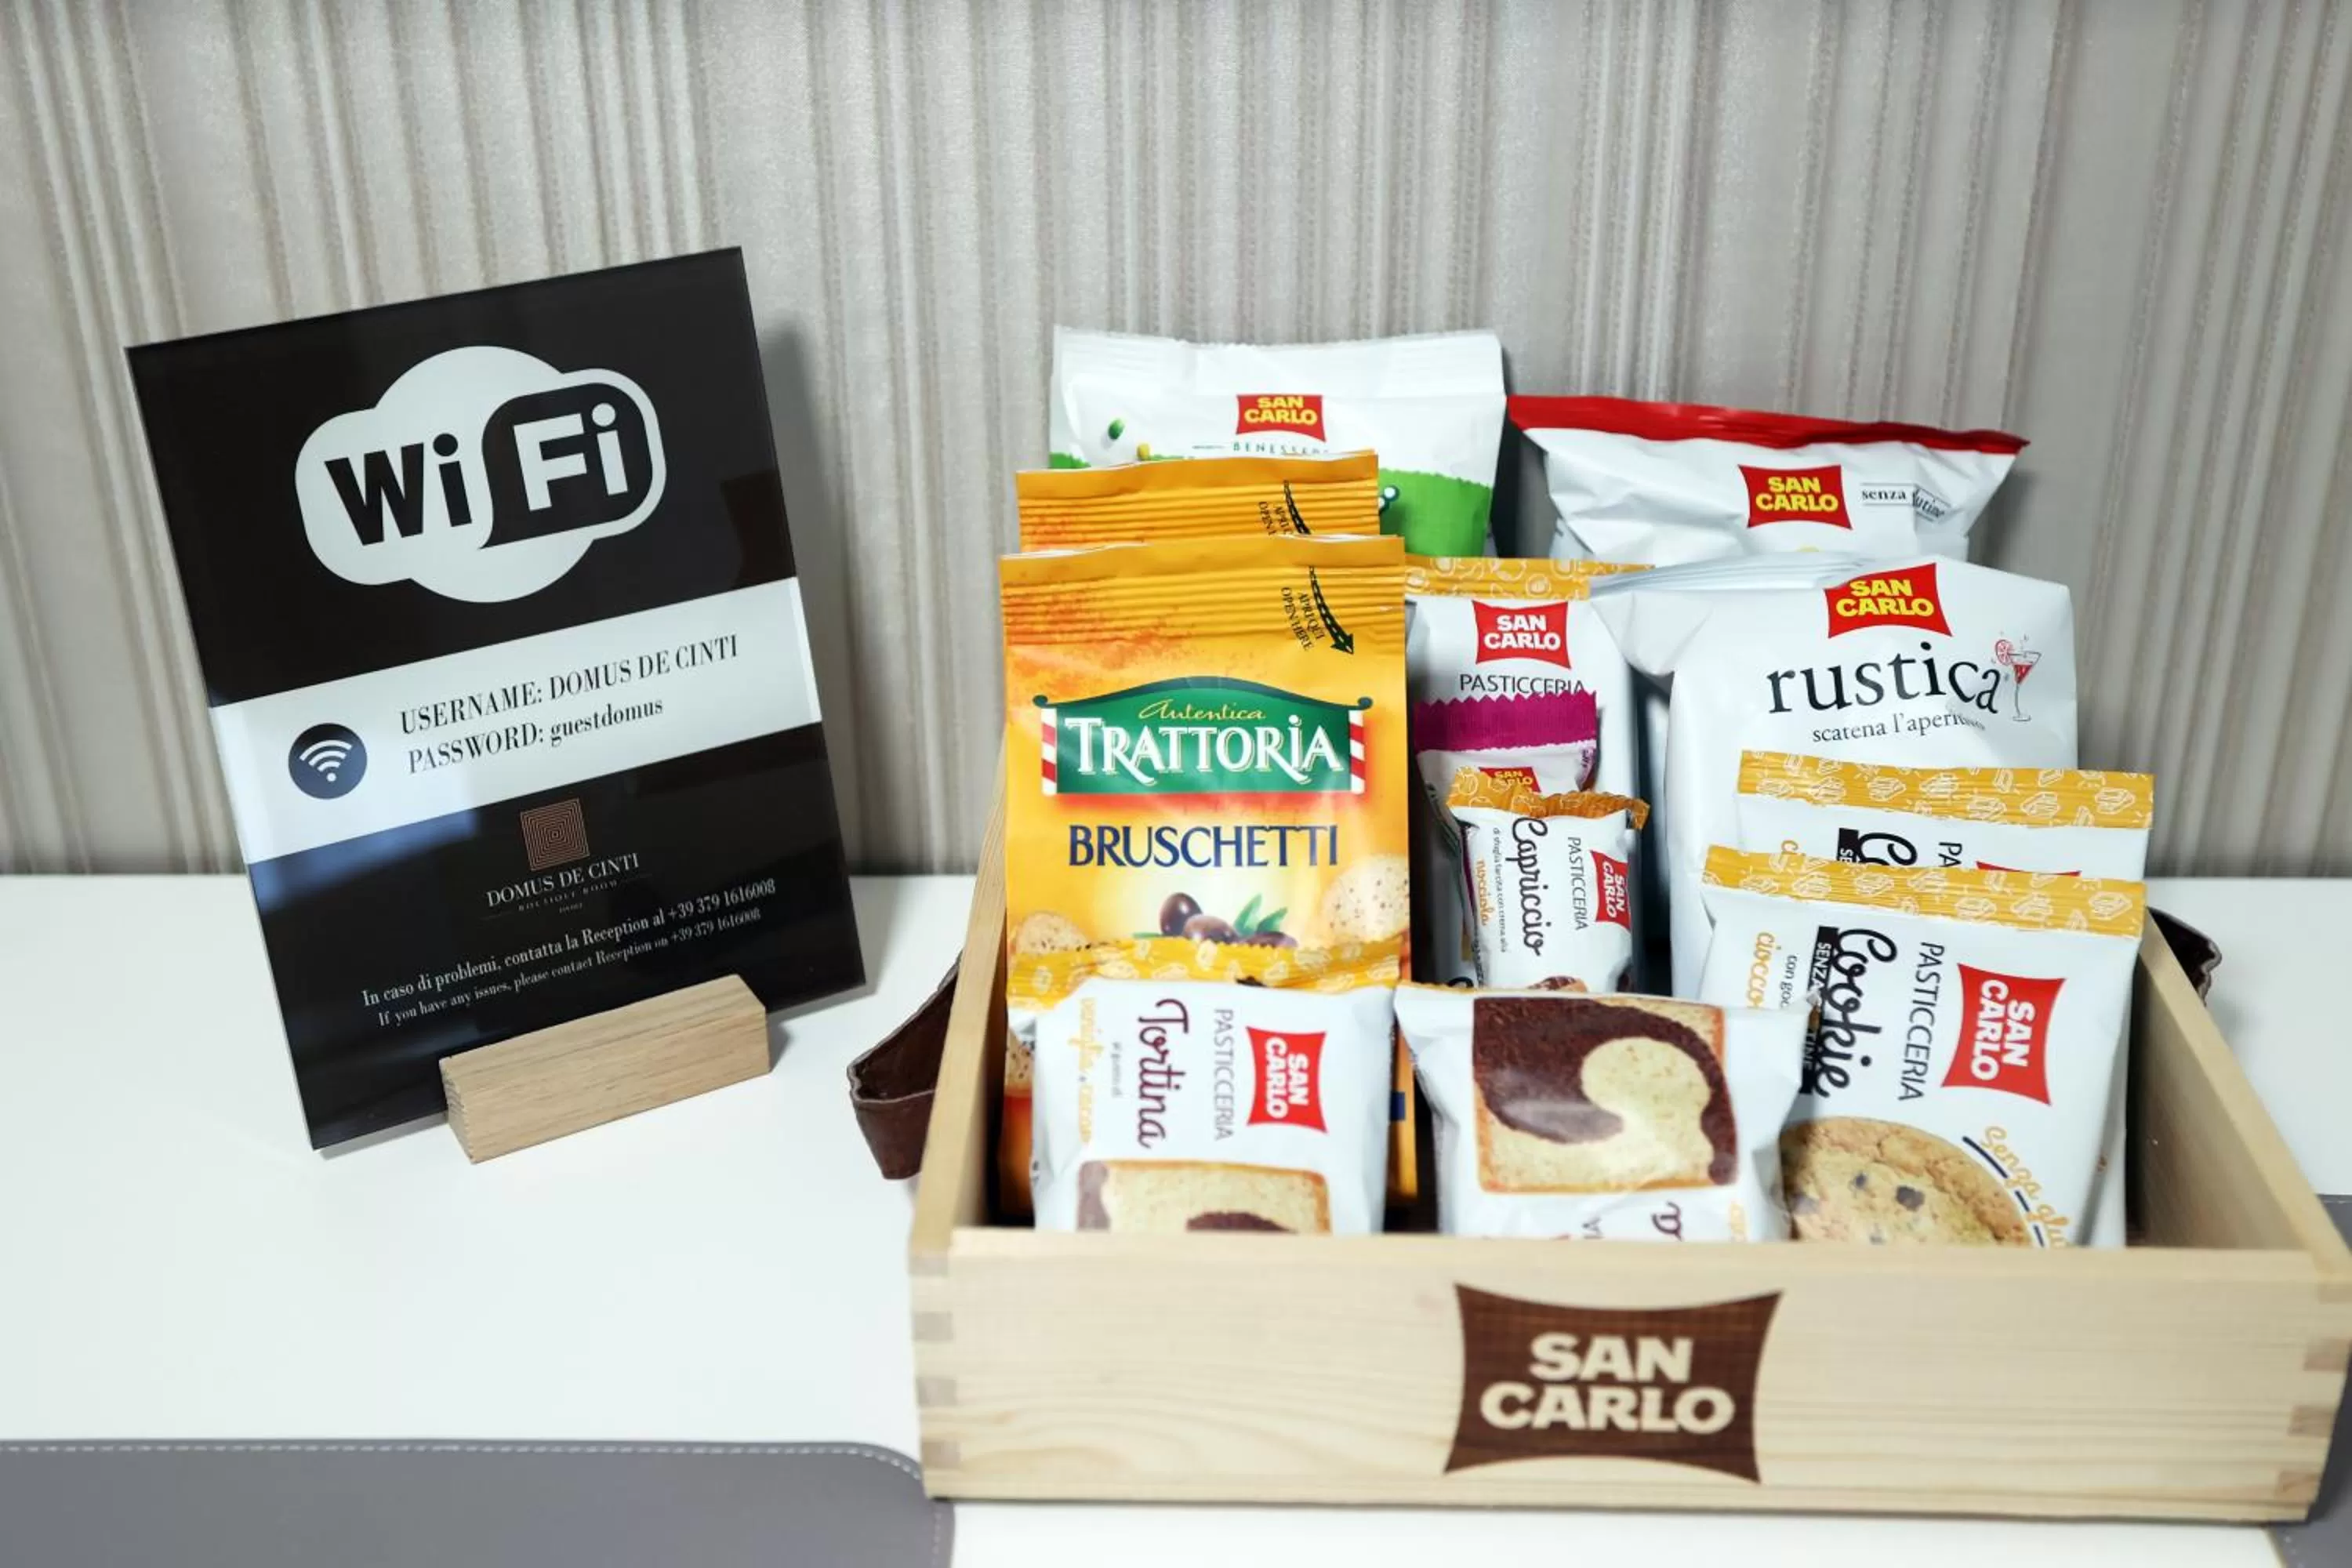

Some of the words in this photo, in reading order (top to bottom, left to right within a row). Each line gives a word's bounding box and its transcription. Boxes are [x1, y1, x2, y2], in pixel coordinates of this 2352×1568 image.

[1243, 408, 1318, 426] CARLO
[1257, 396, 1305, 409] SAN
[1755, 493, 1838, 513] CARLO
[1767, 476, 1820, 493] SAN
[1862, 489, 1906, 500] senza
[1835, 597, 1935, 618] CARLO
[1849, 579, 1913, 598] SAN
[1281, 586, 1296, 620] OPEN
[1290, 615, 1315, 651] HERE
[1298, 592, 1315, 619] APRI
[1307, 619, 1325, 640] QUI
[1484, 632, 1561, 651] CARLO
[1497, 615, 1547, 632] SAN
[400, 681, 543, 735] USERNAME:
[549, 659, 633, 702] DOMUS
[637, 650, 671, 681] DE
[676, 633, 739, 670] CINTI
[1460, 673, 1585, 695] PASTICCERIA
[1766, 641, 2002, 714] rustica
[408, 720, 544, 775] PASSWORD:
[550, 697, 664, 748] guestdomus
[1138, 698, 1267, 721] Autentica
[1813, 721, 1887, 742] scatena
[1069, 825, 1338, 868] BRUSCHETTI
[486, 874, 555, 908] DOMUS
[559, 866, 585, 888] DE
[588, 852, 640, 880] CINTI
[1505, 816, 1552, 956] Capriccio
[1568, 837, 1588, 931] PASTICCERIA
[1602, 862, 1617, 918] CARLO
[1613, 874, 1625, 912] SAN
[361, 989, 380, 1007] In
[383, 984, 415, 1002] caso
[417, 974, 432, 993] di
[434, 956, 502, 993] problemi,
[503, 941, 563, 968] contatta
[565, 934, 579, 950] la
[581, 917, 650, 946] Reception
[652, 907, 666, 926] al
[667, 901, 695, 920] +39
[696, 894, 721, 914] 379
[378, 1011, 390, 1027] If
[394, 1007, 417, 1027] you
[419, 999, 448, 1014] have
[451, 992, 472, 1008] any
[474, 981, 511, 1000] issues,
[514, 971, 550, 994] please
[551, 956, 593, 979] contact
[595, 941, 652, 966] Reception
[670, 926, 693, 943] +39
[694, 918, 716, 936] 379
[1746, 932, 1781, 1010] ciocco
[1784, 955, 1799, 979] con
[1809, 942, 1831, 990] SENZA
[1779, 982, 1794, 1009] goc
[1815, 928, 1897, 1098] Cookie
[1897, 942, 1946, 1102] PASTICCERIA
[1803, 1030, 1818, 1071] TINE
[1971, 979, 2009, 1081] CARLO
[2002, 998, 2037, 1067] SAN
[1137, 998, 1189, 1149] Tortina
[1214, 1008, 1235, 1142] PASTICCERIA
[1266, 1036, 1288, 1118] CARLO
[1289, 1053, 1309, 1105] SAN
[1981, 1126, 2042, 1200] Senza
[1529, 1330, 1693, 1384] SAN
[1479, 1381, 1736, 1435] CARLO
